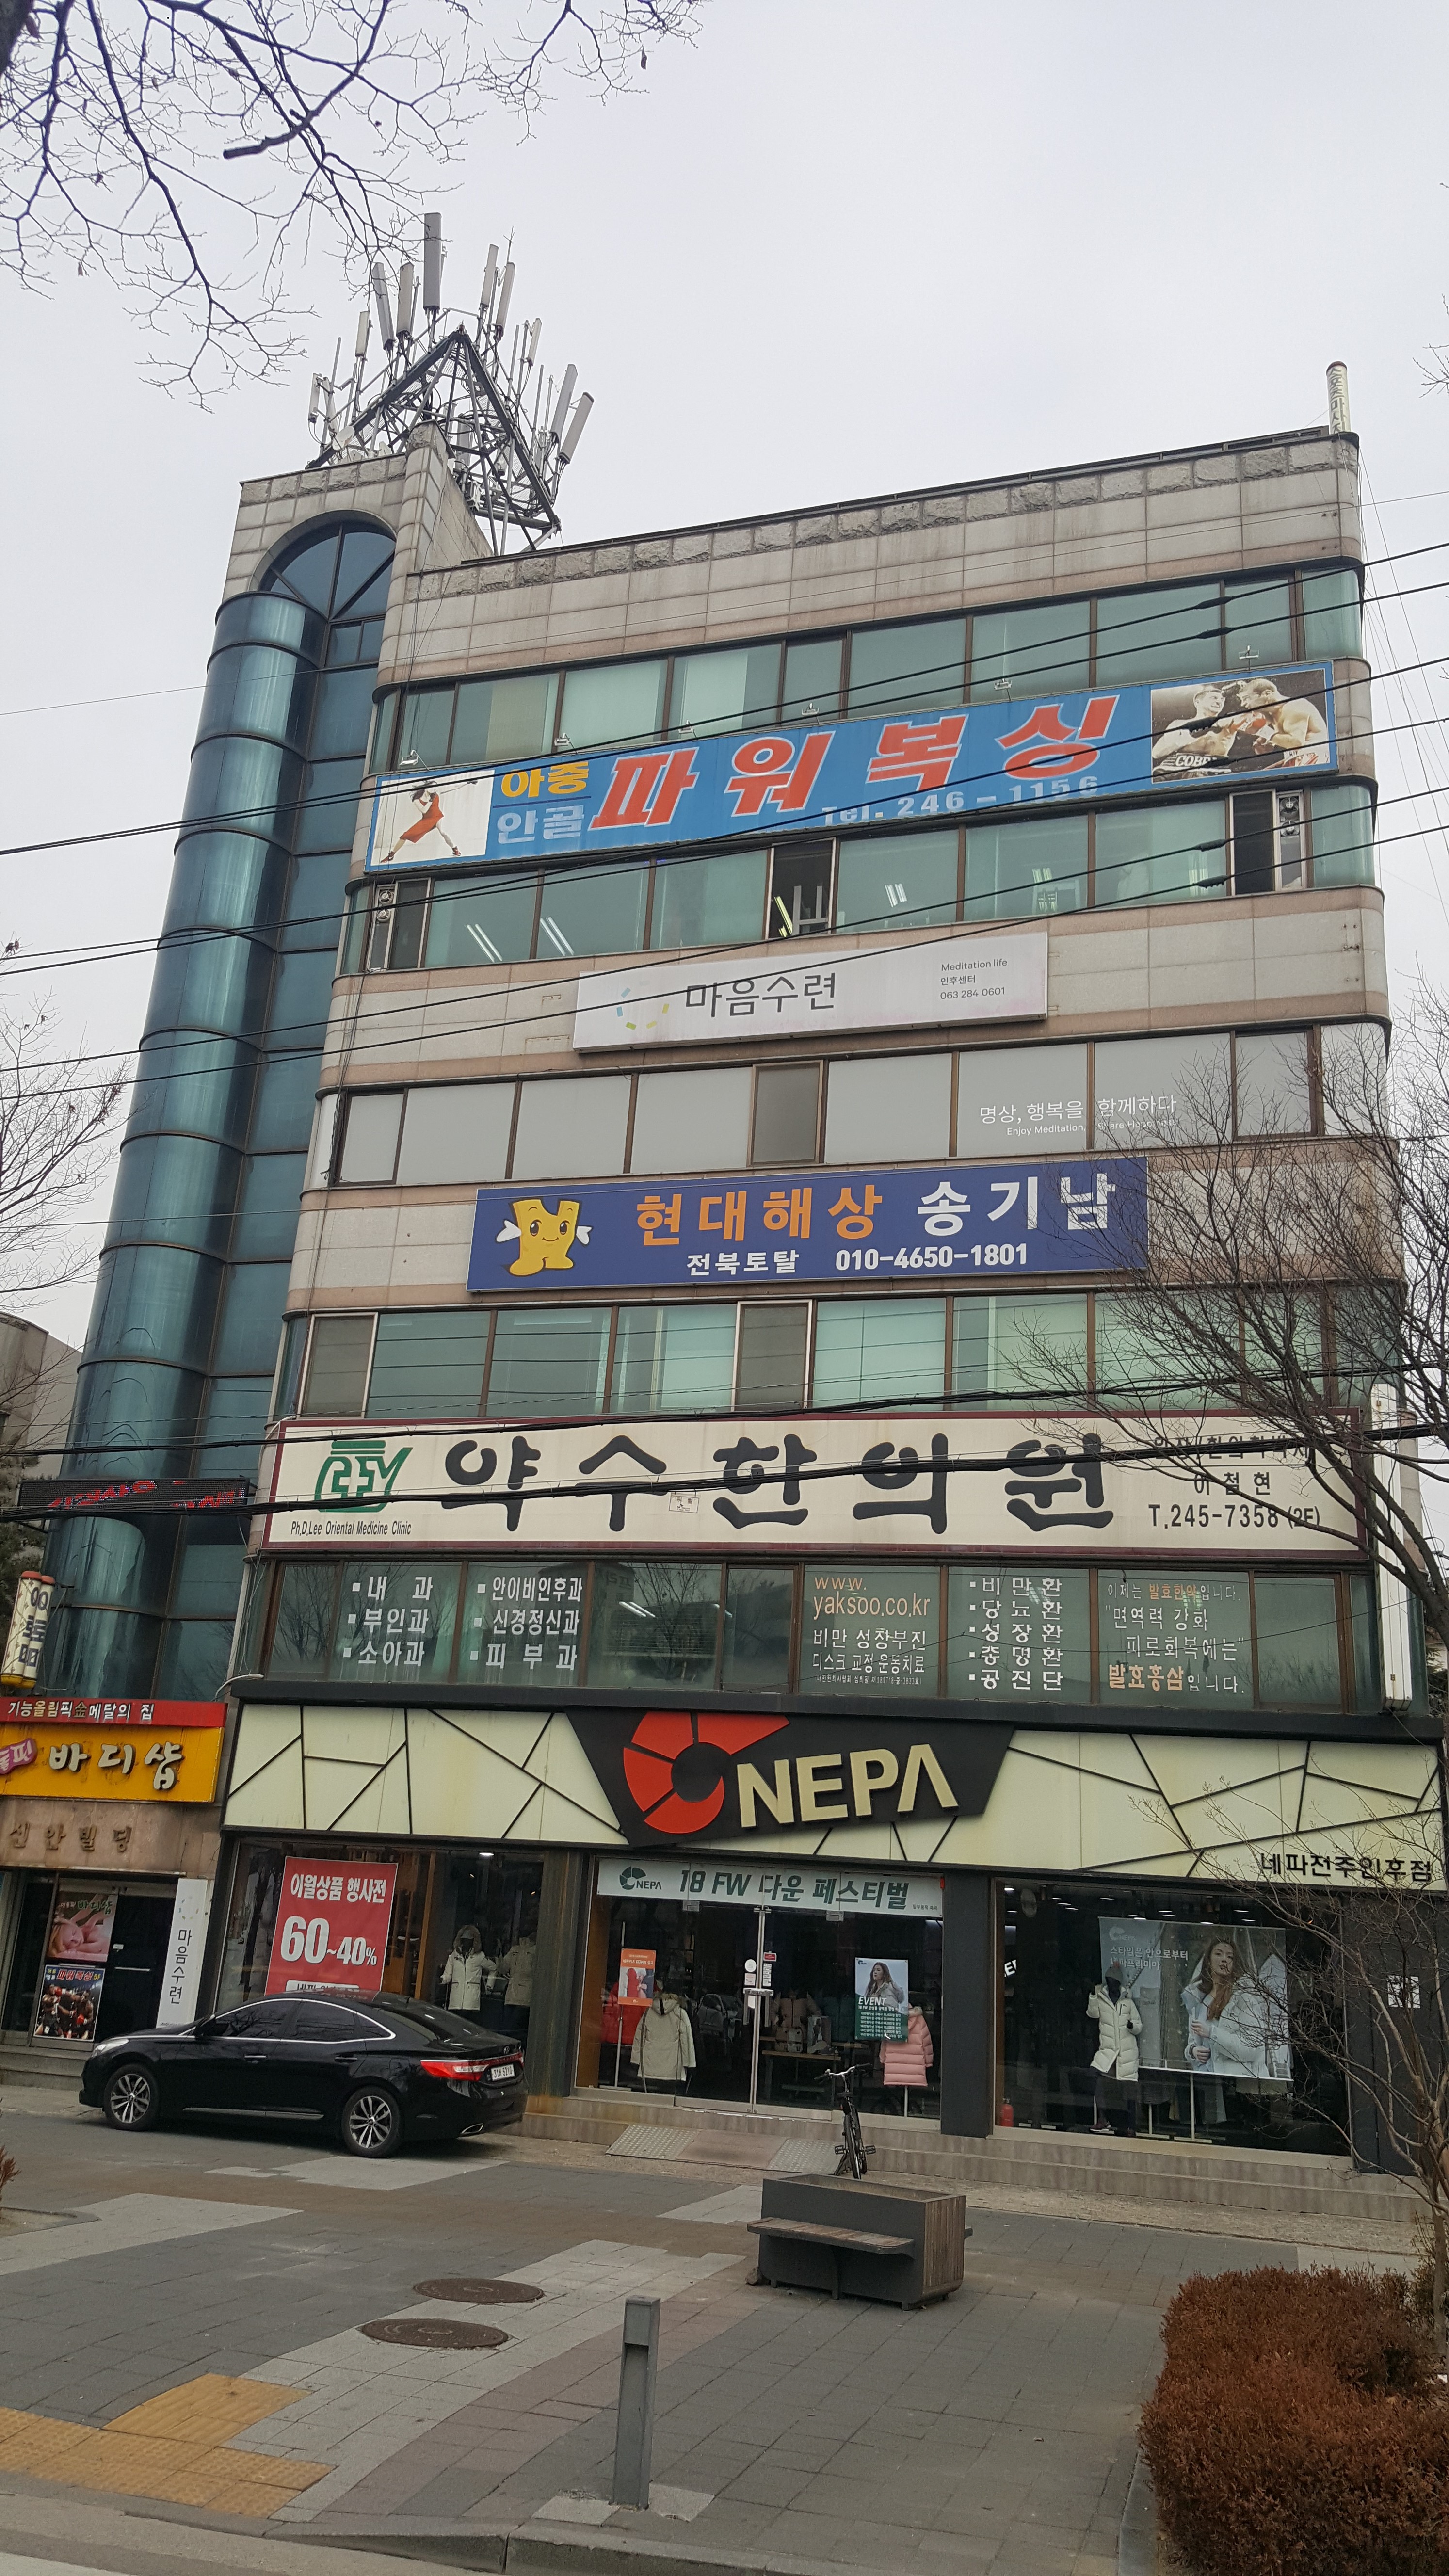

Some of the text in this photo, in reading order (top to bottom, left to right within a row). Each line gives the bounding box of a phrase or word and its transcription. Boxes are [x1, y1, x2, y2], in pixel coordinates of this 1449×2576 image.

[589, 695, 1120, 831] 파워복싱
[501, 762, 589, 798] 아중
[497, 804, 584, 845] 안골
[941, 958, 1008, 972] Meditation life
[940, 974, 976, 986] 인후센터
[685, 972, 836, 1018] 마음수련
[940, 987, 1005, 1000] 063 284 0601
[980, 1094, 1177, 1125] 명상, 행복을 함께하다
[1007, 1126, 1031, 1137] Enjoy
[1034, 1124, 1086, 1135] Meditation,
[637, 1172, 1116, 1246] 현대해상 송기남
[687, 1242, 1027, 1276] 전북토탈 010-4650-1801
[441, 1433, 1113, 1534] 약수한의원
[325, 1520, 354, 1535] Oriental
[356, 1521, 388, 1535] Medicine
[392, 1520, 411, 1535] Clinic
[1149, 1503, 1278, 1530] T.245-7358
[493, 1577, 582, 1602] 안이비인후과
[814, 1576, 867, 1590] www.
[1108, 1583, 1142, 1599] 이제는
[813, 1592, 930, 1620] yaksoo.co.kr
[363, 1608, 429, 1633] 부인과
[493, 1610, 580, 1635] 신경정신과
[1174, 1608, 1208, 1631] 강화
[814, 1629, 847, 1649] 비만
[358, 1641, 424, 1667] 소아과
[812, 1653, 925, 1674] 디스크 교정 운동치료
[140, 1703, 154, 1721] 집
[49, 1741, 183, 1790] 바디샵
[737, 1743, 959, 1829] NEPA
[1261, 1853, 1431, 1882] 네파전주인후점
[290, 1873, 387, 1904] 이월상품 행사전
[636, 1869, 909, 1910] NEPA 18 FW 다운 페스티벌
[169, 1929, 193, 2004] 마음수련
[1111, 1947, 1188, 1961] 스타일은 안으로부터
[858, 1996, 887, 2006] EVENT
